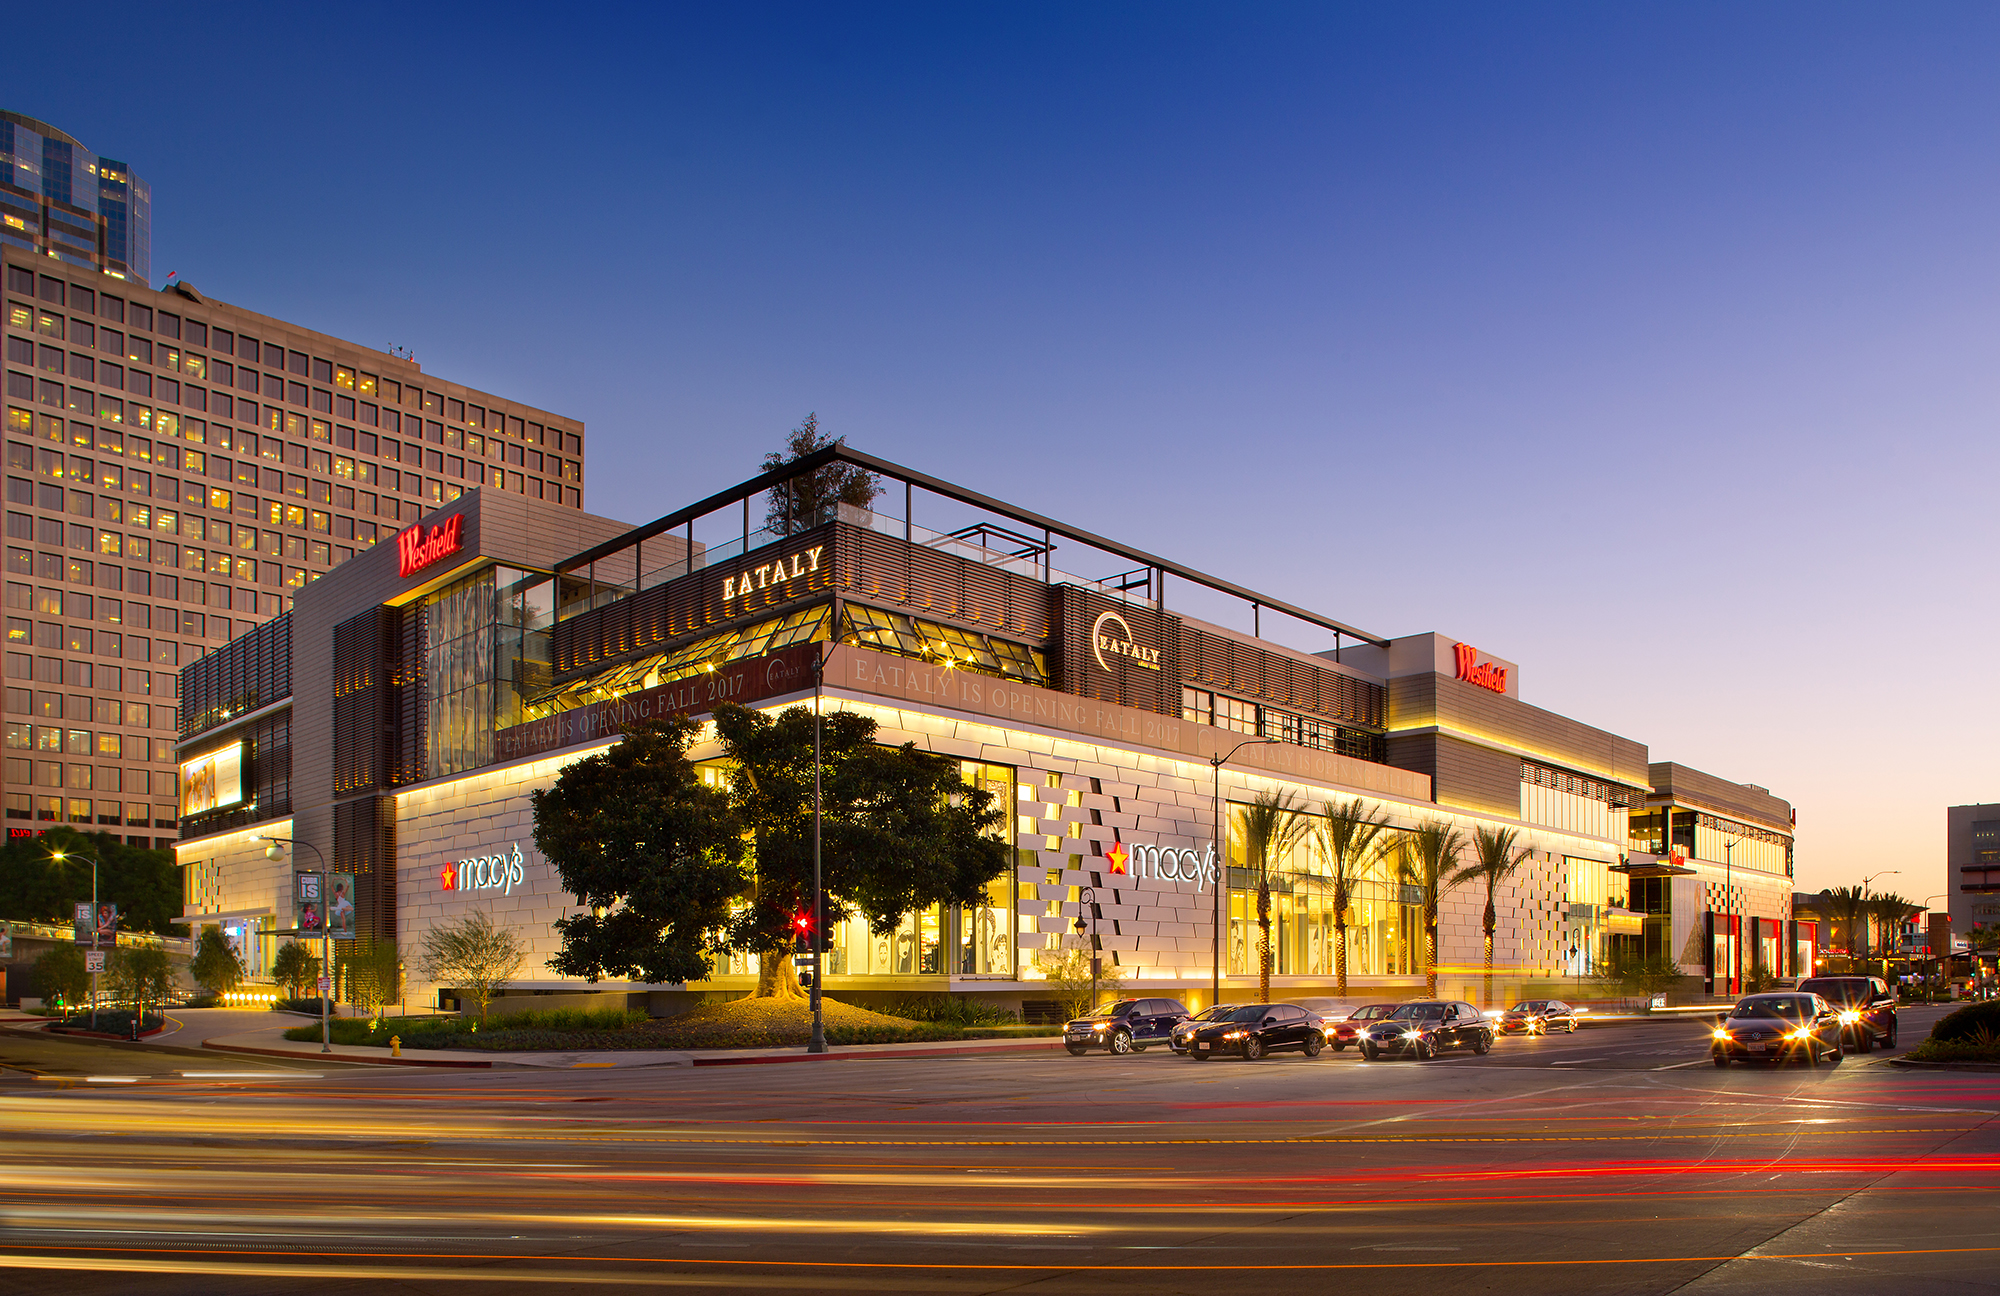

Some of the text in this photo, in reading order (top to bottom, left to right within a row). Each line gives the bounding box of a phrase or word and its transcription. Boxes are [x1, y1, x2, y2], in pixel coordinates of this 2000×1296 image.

[397, 513, 464, 578] Westfield
[722, 545, 823, 601] EATALY
[769, 665, 801, 681] EATALY
[1099, 635, 1161, 663] EATALY
[1452, 641, 1508, 693] Westfield
[505, 673, 744, 752] EATALY IS OPENING FALL 2017
[854, 658, 1180, 743] EATALY IS OPENING FALL 2017
[1240, 744, 1427, 795] EATALY IS OPENING FALL 2017
[301, 884, 319, 898] IS
[458, 842, 524, 896] macy's
[1129, 841, 1222, 893] macy's
[77, 910, 91, 919] IS
[88, 962, 104, 971] 35
